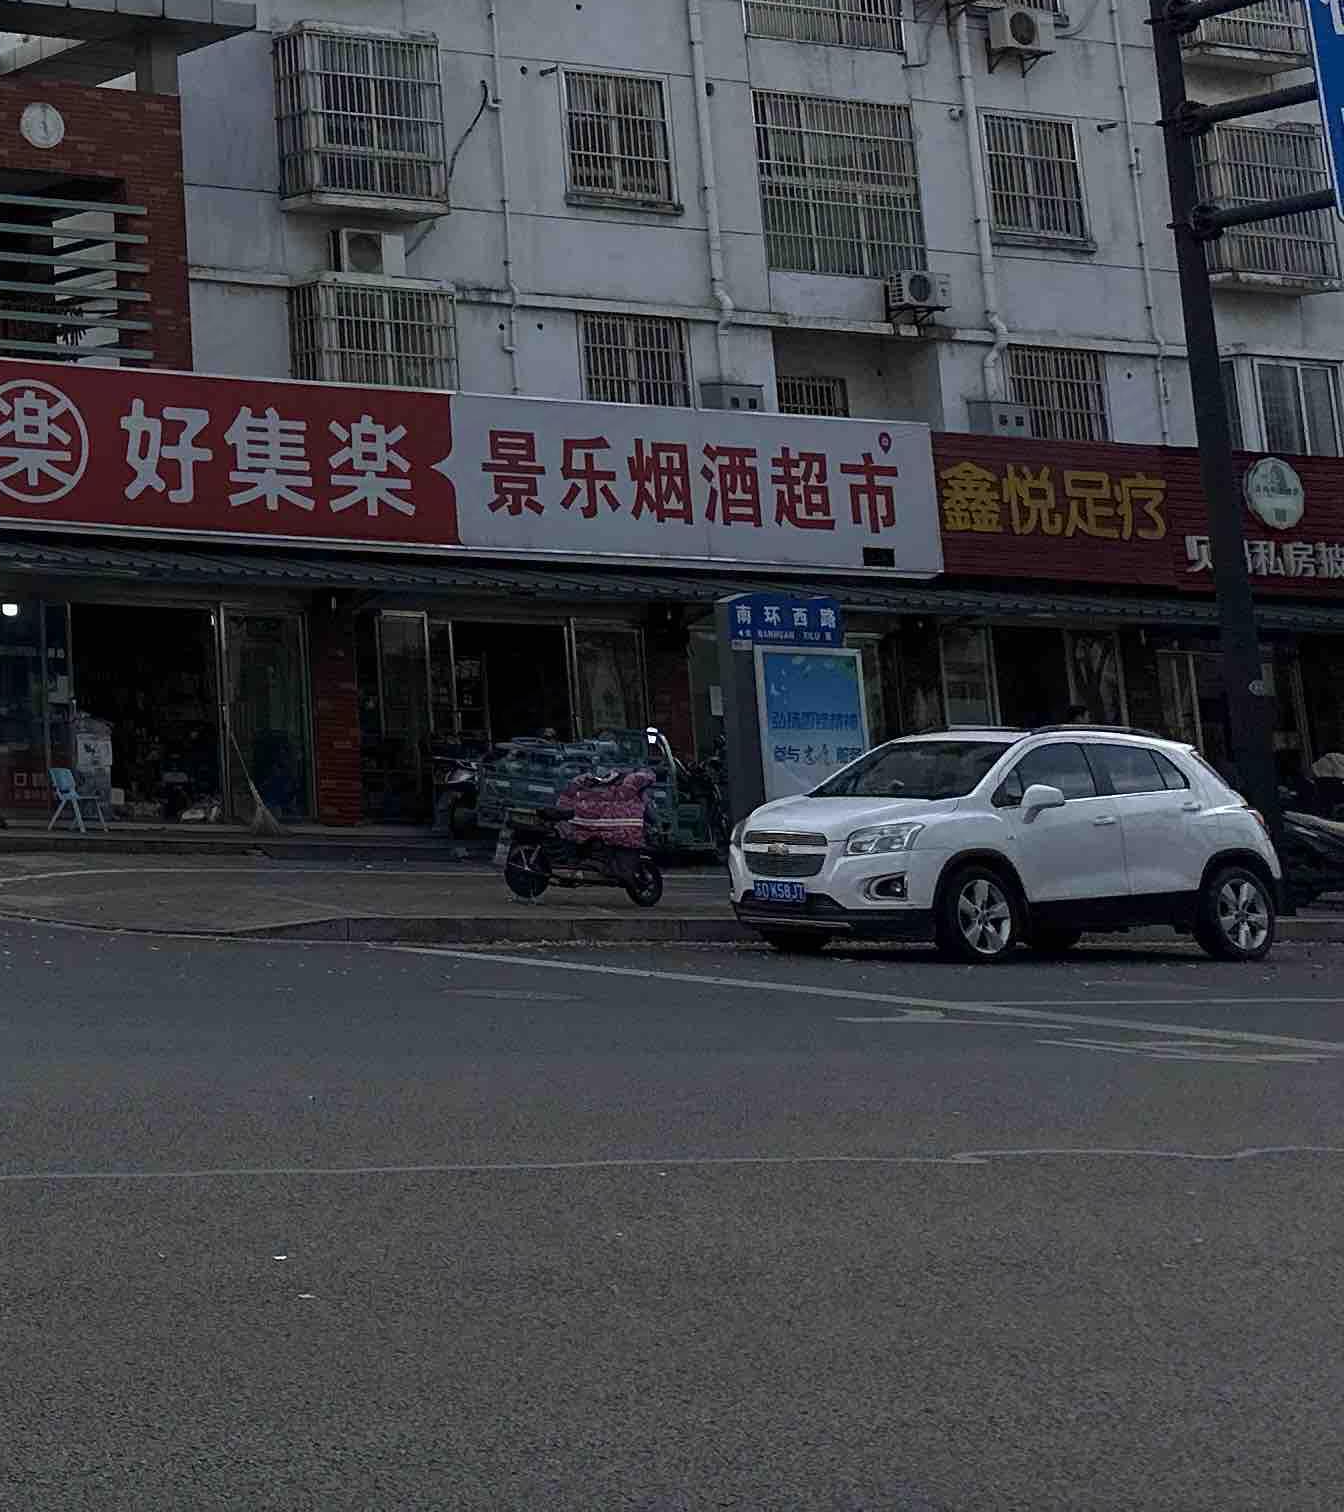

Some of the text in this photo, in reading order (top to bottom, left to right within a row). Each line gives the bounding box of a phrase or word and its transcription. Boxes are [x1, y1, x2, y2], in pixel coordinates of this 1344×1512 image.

[480, 429, 899, 535] 景乐烟酒超市
[941, 460, 1168, 542] 鑫悦足疗
[734, 603, 837, 629] 南环西路
